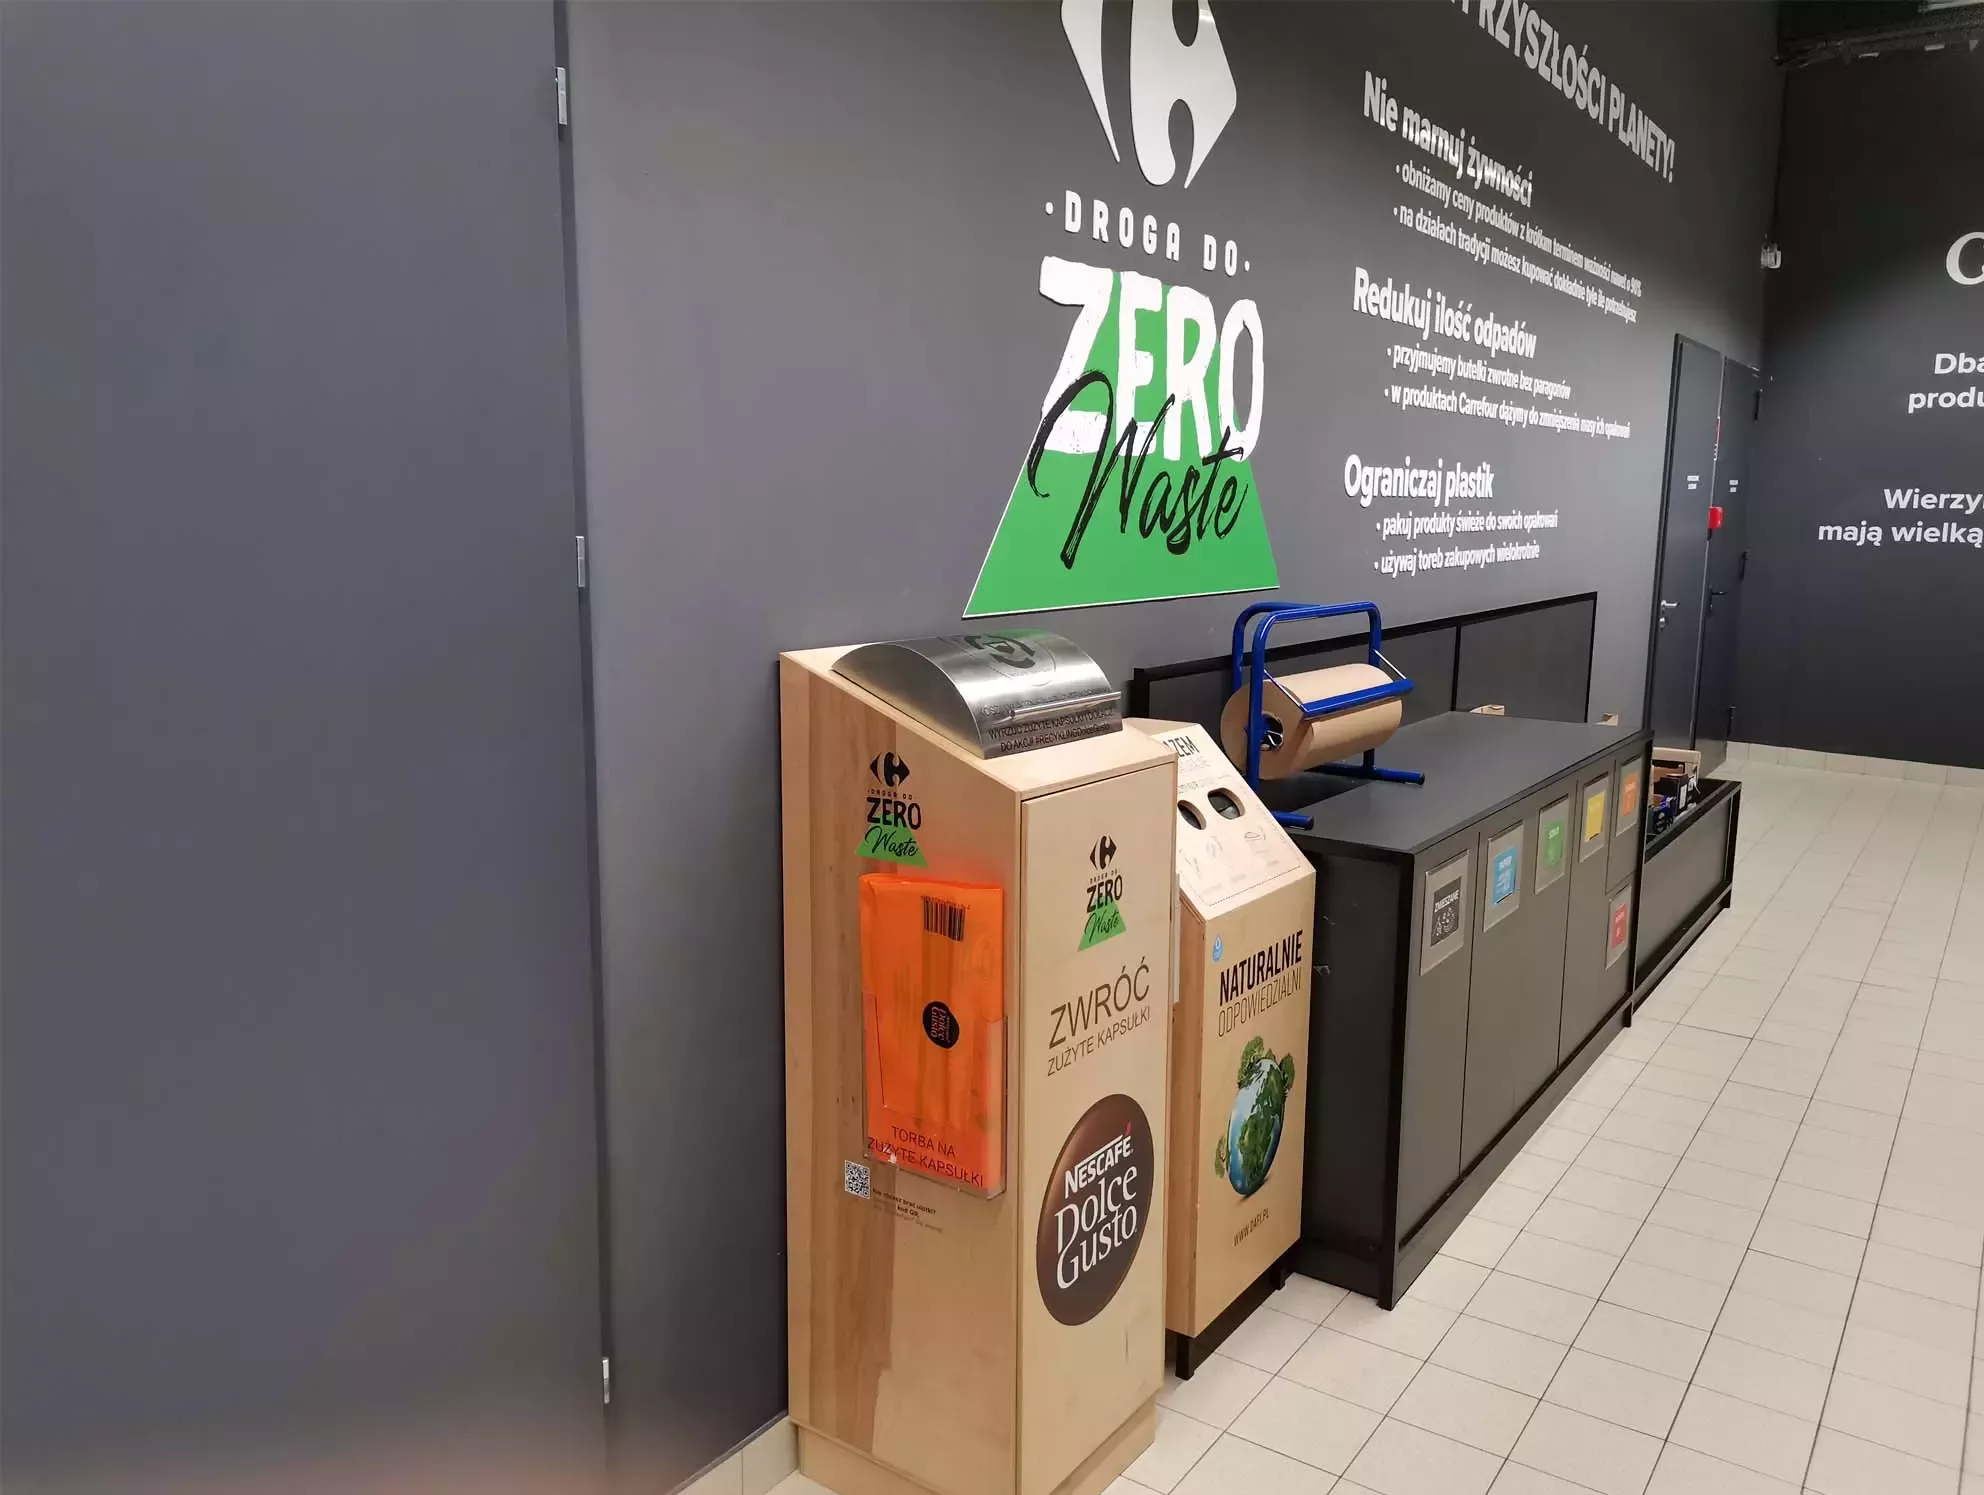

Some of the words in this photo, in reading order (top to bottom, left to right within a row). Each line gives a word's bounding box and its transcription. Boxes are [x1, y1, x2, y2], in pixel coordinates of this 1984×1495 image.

[1462, 0, 1606, 124] RZYSZŁOŚCI
[1608, 83, 1675, 183] PLANETY!
[1363, 70, 1398, 131] Nie
[1402, 106, 1465, 179] marnuj
[1467, 136, 1533, 207] żywności
[1065, 190, 1180, 262] DROGA
[1203, 234, 1238, 276] DO
[1402, 160, 1451, 208] obniżamy
[1453, 189, 1475, 219] ceny
[1475, 201, 1519, 237] produktów
[1520, 224, 1525, 240] z
[1526, 222, 1552, 253] krótkim
[1400, 205, 1413, 227] na
[1416, 208, 1456, 246] działach
[1491, 246, 1521, 273] możesz
[1522, 256, 1554, 287] kupować
[1554, 271, 1585, 300] dokładnie
[1353, 266, 1431, 340] Redukuj
[1435, 291, 1472, 341] ilość
[1474, 312, 1537, 358] odpadów
[1039, 255, 1264, 462] ZERO
[1393, 343, 1457, 380] przyjmujemy
[1457, 354, 1487, 382] butelki
[1487, 366, 1519, 389] zwrotne
[1520, 370, 1532, 392] bez
[1533, 379, 1571, 400] paragonów
[1391, 385, 1401, 403] w
[1403, 385, 1457, 410] produktach
[1459, 392, 1498, 419] Carrefour
[1499, 400, 1528, 428] dążymy
[1529, 405, 1539, 425] do
[1027, 369, 1249, 569] Waste
[1345, 454, 1443, 507] Ograniczaj
[1444, 461, 1494, 506] plastik
[1884, 488, 1984, 515] Wierzy
[1382, 511, 1412, 540] pakuj
[1413, 512, 1455, 538] produkty
[1455, 509, 1485, 532] świeże
[1486, 511, 1496, 531] do
[1497, 509, 1522, 530] swoich
[1523, 509, 1559, 533] opakowań
[1818, 520, 1882, 546] mają
[1891, 521, 1984, 548] wielką
[1381, 549, 1417, 578] używaj
[1418, 546, 1444, 571] toreb
[1444, 543, 1495, 570] zakupowych
[864, 825, 919, 857] Waste
[866, 796, 922, 830] ZERO
[1084, 910, 1120, 943] Waste
[1086, 874, 1123, 913] ZERO
[1048, 955, 1150, 1049] ZWRÓĆ
[1218, 966, 1302, 1037] ODPOWIEDZIALNI
[1219, 929, 1304, 1007] NATURALNIE
[1047, 1035, 1094, 1077] ZUŻYTE
[1097, 1005, 1150, 1049] KAPSUŁKI
[891, 1125, 935, 1150] TORBA
[937, 1140, 956, 1159] NA
[920, 1155, 984, 1188] KAPSUŁKI
[1064, 1121, 1133, 1199] NESCAFÉ
[1054, 1165, 1138, 1254] Dolce
[1056, 1204, 1137, 1289] Gusto
